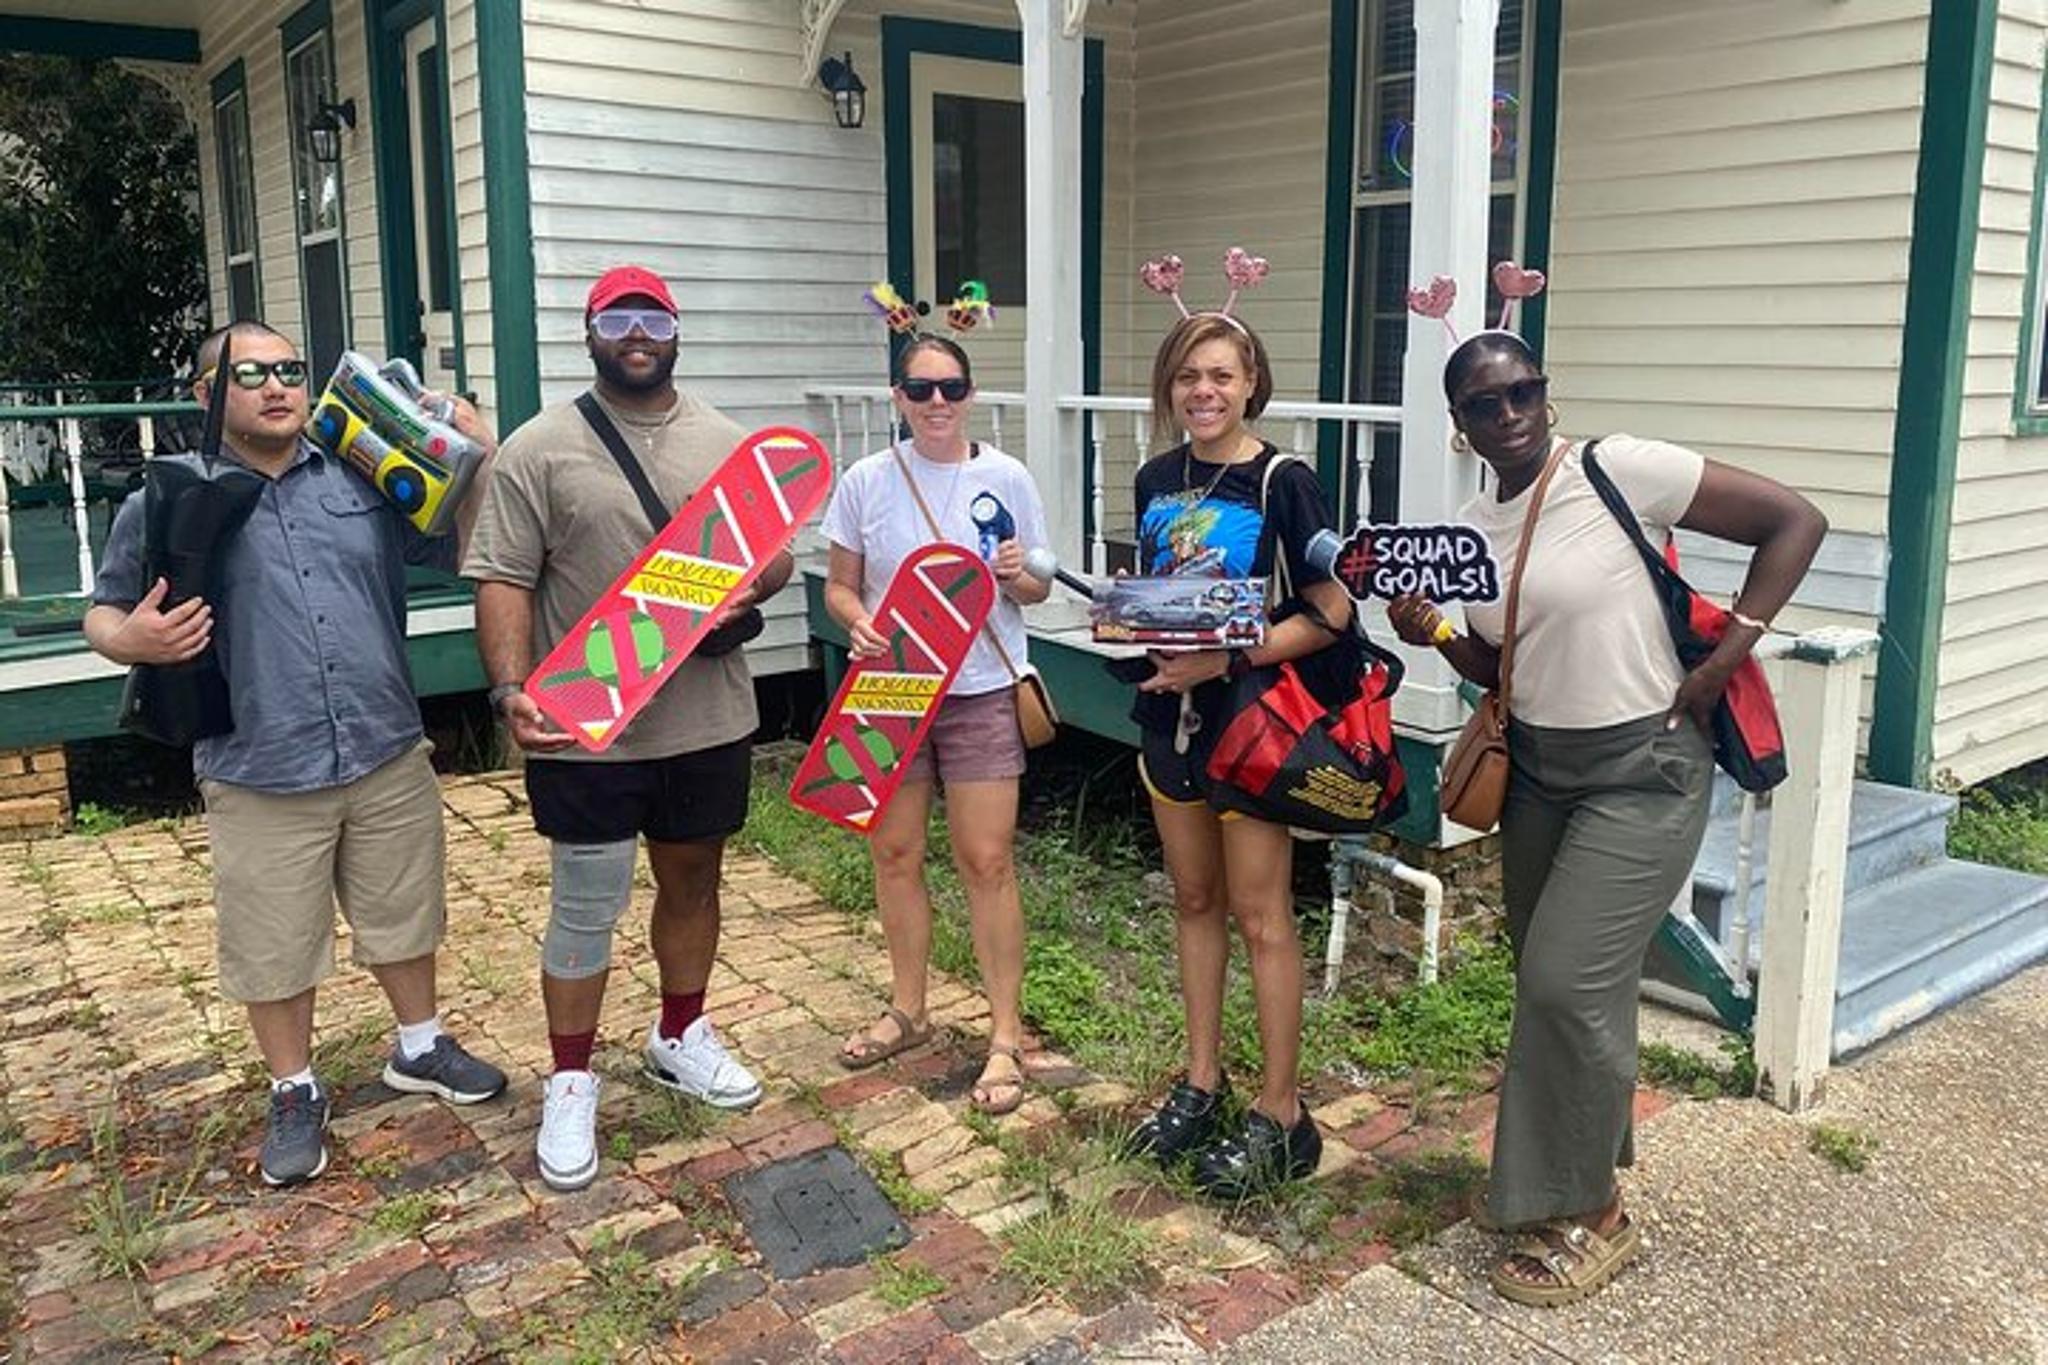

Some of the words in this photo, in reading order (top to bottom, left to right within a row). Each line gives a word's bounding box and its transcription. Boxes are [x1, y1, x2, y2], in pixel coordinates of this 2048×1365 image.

[650, 555, 734, 584] HOVER
[1373, 565, 1490, 597] GOALS!
[857, 675, 935, 692] HOVER
